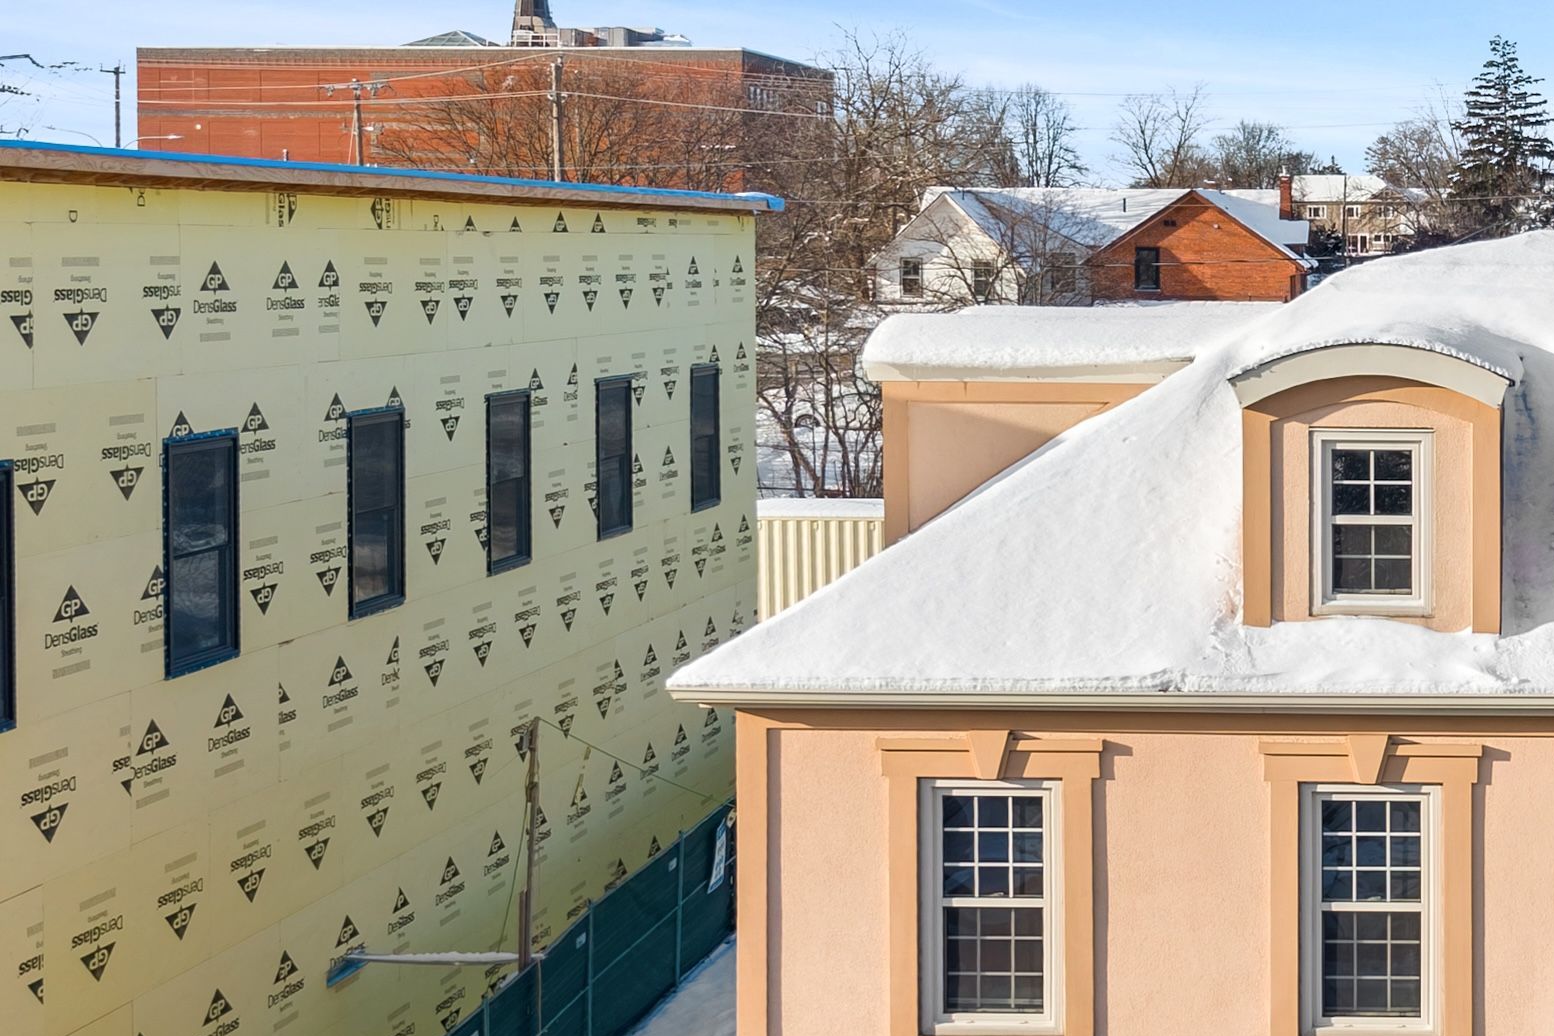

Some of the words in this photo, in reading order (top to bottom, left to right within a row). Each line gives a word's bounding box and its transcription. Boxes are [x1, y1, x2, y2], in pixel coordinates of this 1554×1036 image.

[207, 274, 223, 289] GP
[278, 273, 292, 287] GP
[323, 272, 337, 284] GP
[53, 288, 107, 304] DensGlass
[267, 296, 304, 310] DensGlass
[193, 299, 237, 313] DensGlass
[72, 314, 92, 331] GP
[159, 312, 176, 326] GP
[102, 443, 151, 461] DensGlass
[118, 470, 137, 487] GP
[28, 484, 48, 501] GP
[310, 546, 347, 564] DensGlass
[243, 561, 283, 580] DensGlass
[322, 570, 336, 585] GP
[257, 588, 272, 603] GP
[61, 599, 80, 617] GP
[45, 624, 98, 649] DensGlass
[333, 666, 347, 682] GP
[323, 686, 358, 708] DensGlass
[220, 705, 236, 722] GP
[143, 732, 161, 750] GP
[208, 727, 250, 752] DensGlass
[130, 752, 176, 780] DensGlass
[21, 776, 76, 806] DensGlass
[40, 810, 60, 830] GP
[299, 815, 335, 840] DensGlass
[230, 844, 271, 872] DensGlass
[311, 844, 325, 859] GP
[244, 873, 259, 891] GP
[157, 878, 203, 908] DensGlass
[173, 910, 190, 929] GP
[72, 915, 123, 949] DensGlass
[340, 925, 353, 942] GP
[89, 949, 108, 970] GP
[268, 978, 304, 1008] DensGlass
[209, 1000, 224, 1019] GP
